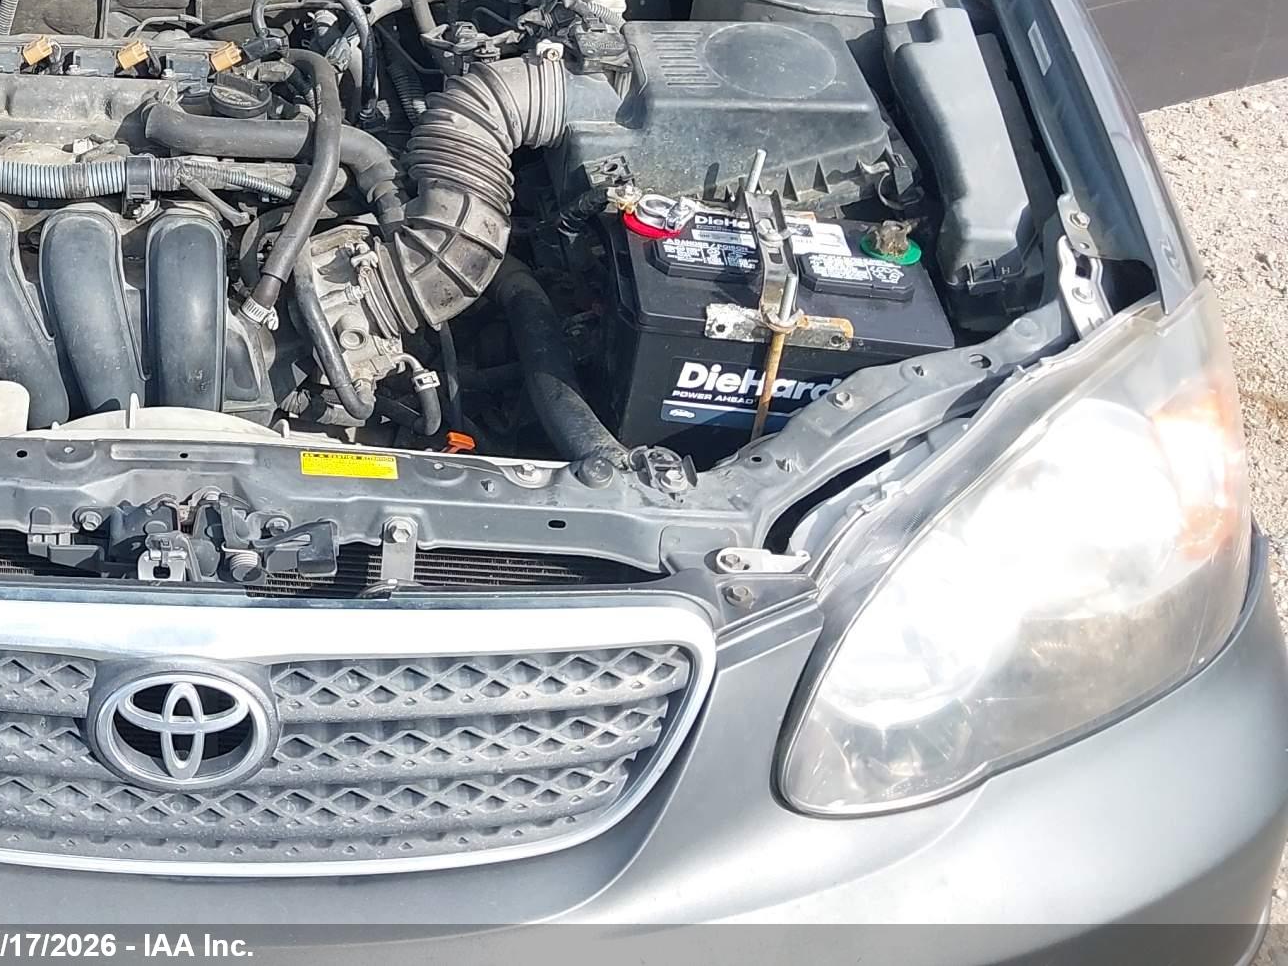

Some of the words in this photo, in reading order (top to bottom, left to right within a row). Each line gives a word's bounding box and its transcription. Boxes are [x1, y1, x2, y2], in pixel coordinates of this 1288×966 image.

[694, 214, 751, 229] DieHa
[672, 390, 713, 402] POWER
[714, 394, 754, 405] AHEAD
